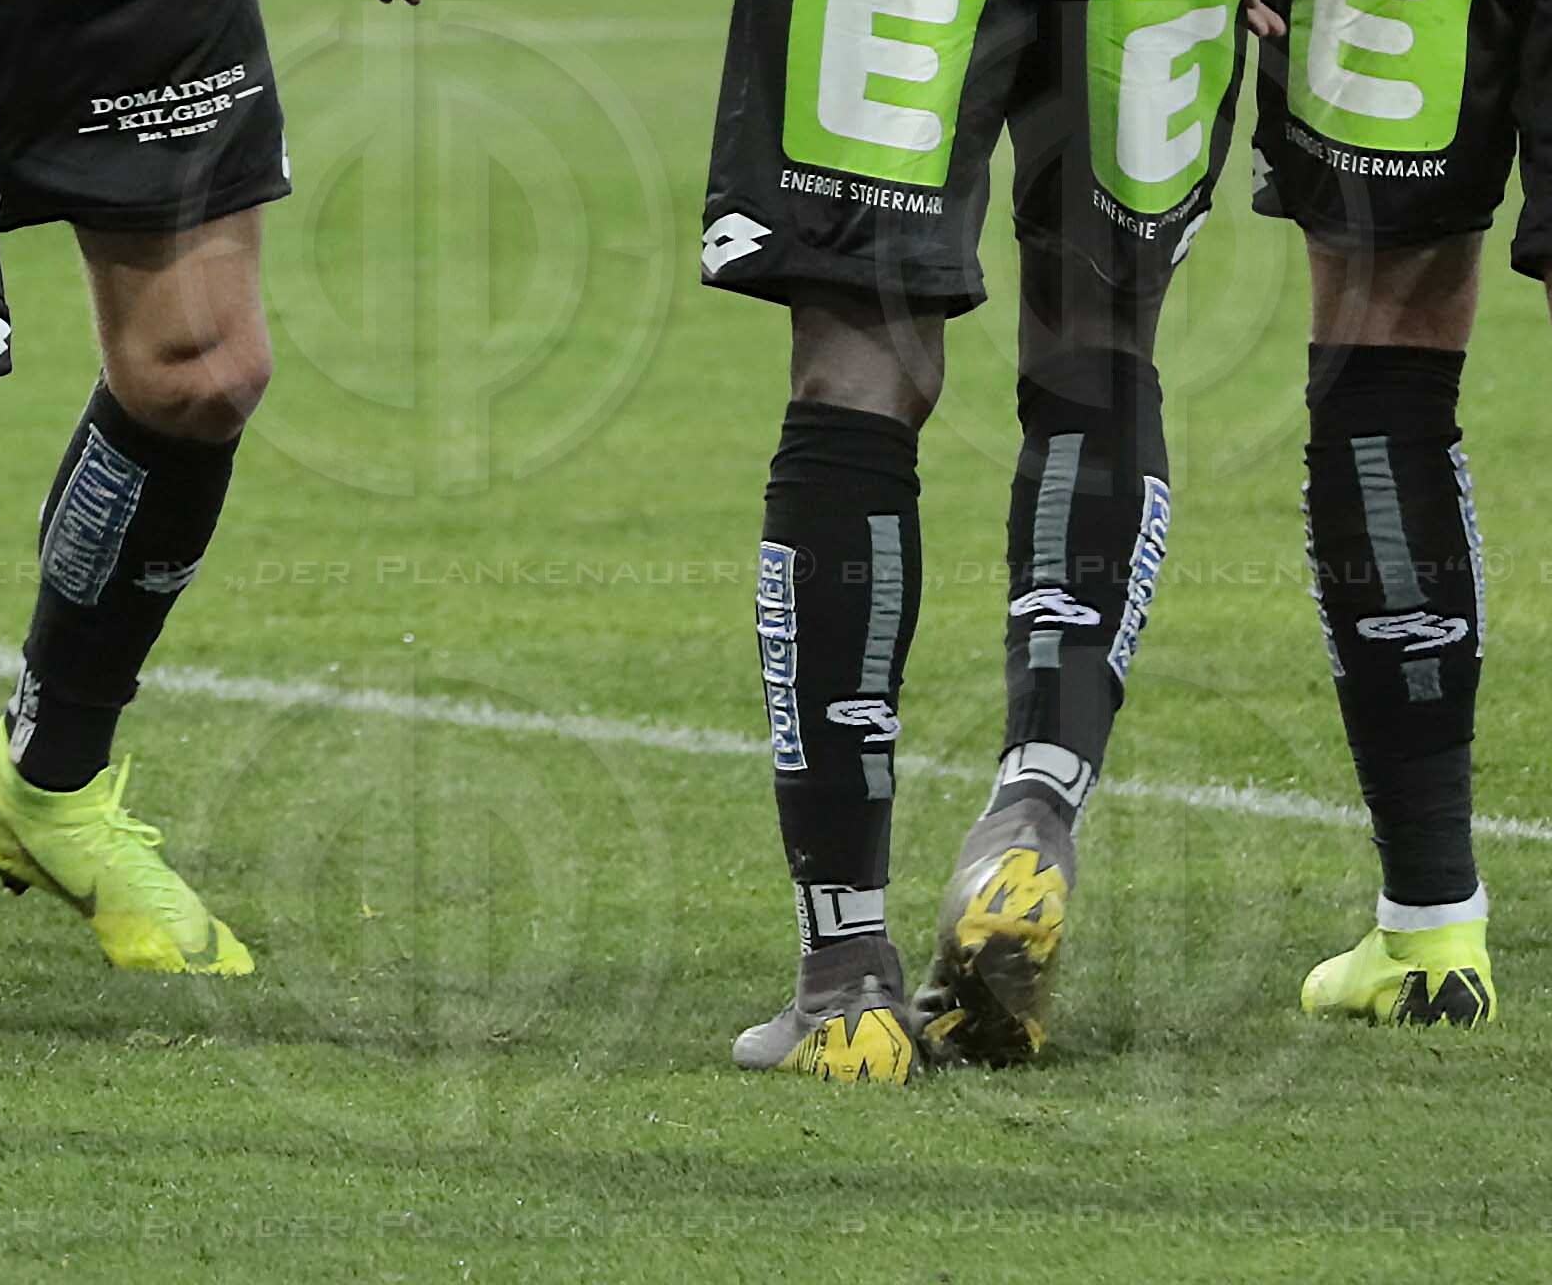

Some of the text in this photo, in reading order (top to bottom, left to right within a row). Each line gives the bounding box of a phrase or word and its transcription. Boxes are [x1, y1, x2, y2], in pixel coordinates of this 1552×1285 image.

[91, 64, 246, 114] DOMAINES
[117, 93, 233, 130] KILGER
[1116, 4, 1228, 183] E
